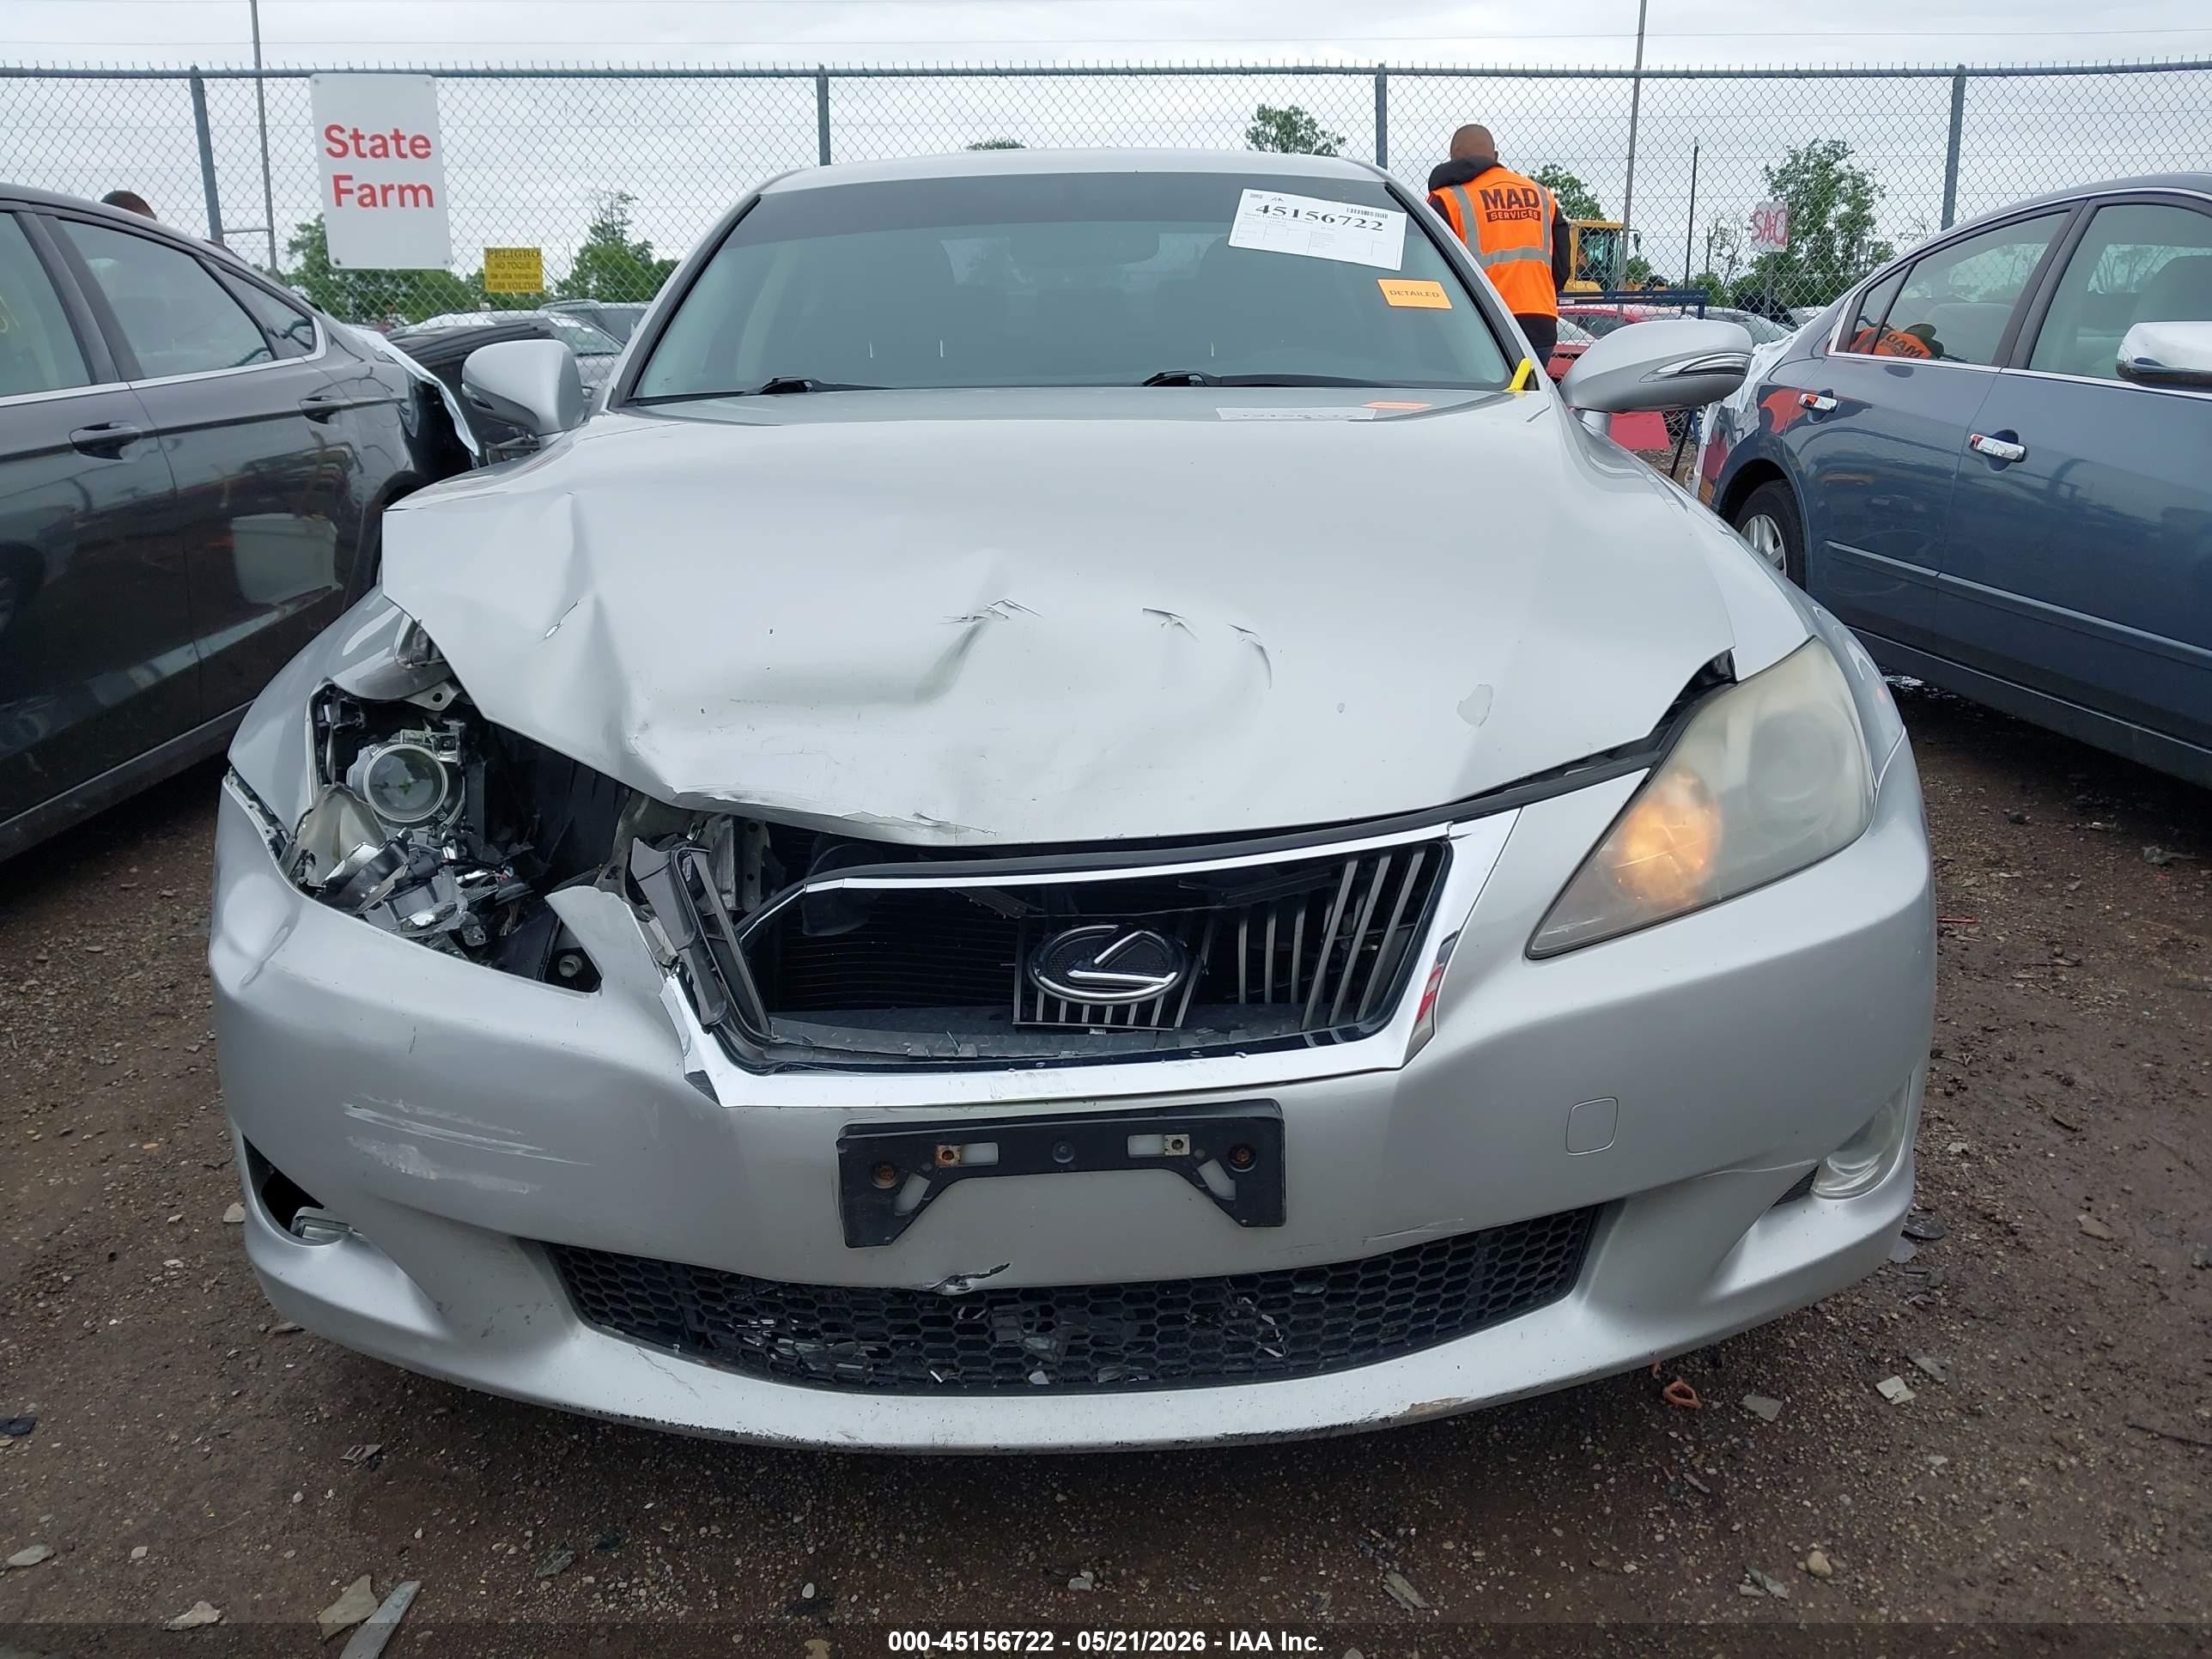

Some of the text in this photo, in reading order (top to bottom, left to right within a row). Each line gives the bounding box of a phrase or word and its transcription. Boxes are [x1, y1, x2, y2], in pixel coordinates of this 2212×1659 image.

[325, 125, 432, 160] State
[332, 174, 434, 208] Farm
[1480, 188, 1540, 210] MAD
[1255, 204, 1384, 232] 45156722
[1490, 210, 1539, 221] SERVICES
[1389, 289, 1440, 298] DETAILED
